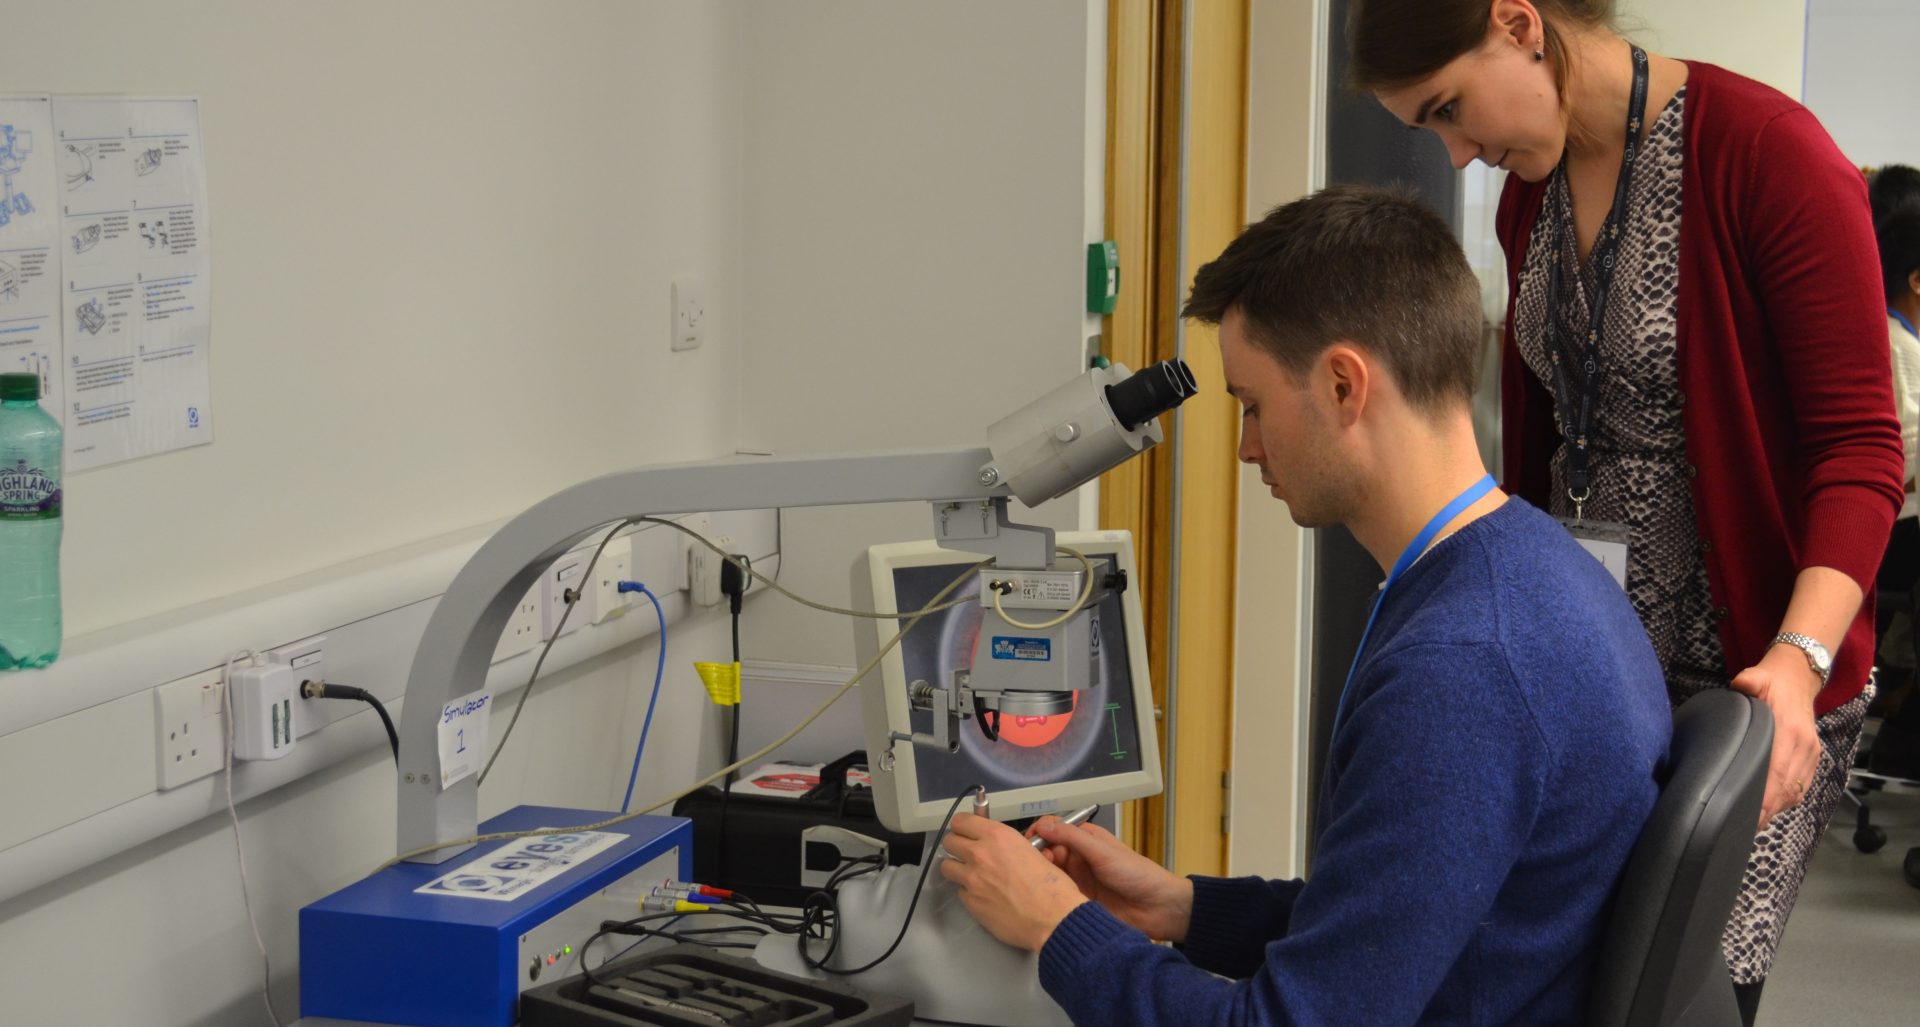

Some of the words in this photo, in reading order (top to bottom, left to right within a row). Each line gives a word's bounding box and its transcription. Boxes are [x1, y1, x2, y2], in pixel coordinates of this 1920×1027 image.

[3, 490, 40, 500] SPRING
[444, 695, 490, 724] Simulator
[456, 728, 466, 754] 1
[490, 831, 592, 870] eyes
